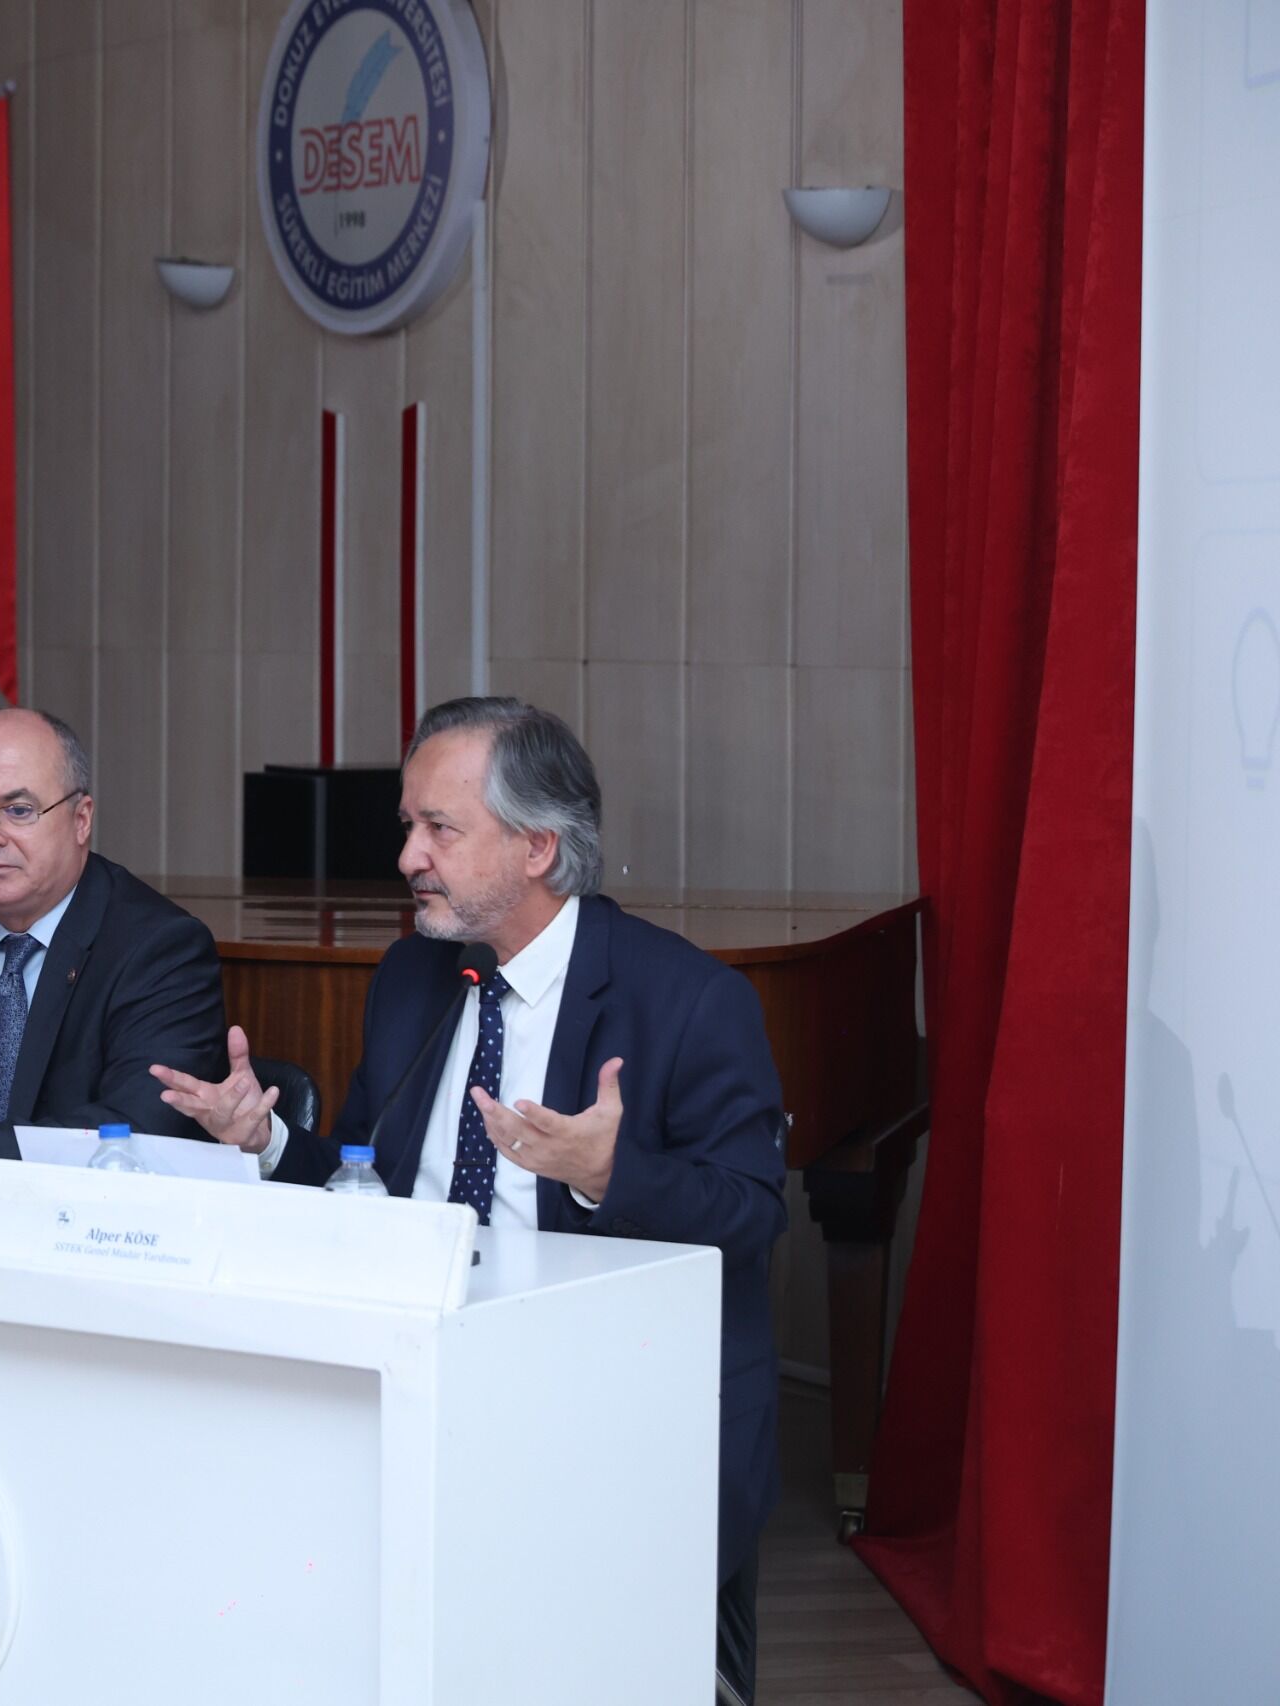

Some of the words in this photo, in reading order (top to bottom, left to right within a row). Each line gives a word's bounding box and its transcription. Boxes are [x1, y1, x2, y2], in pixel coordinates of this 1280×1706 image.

[275, 21, 315, 128] DOKUZ
[386, 0, 451, 107] ERSİTESİ
[299, 114, 421, 195] DESEM
[326, 268, 387, 300] EĞİTİM
[86, 1227, 122, 1244] Alper
[124, 1229, 160, 1247] KÖSE
